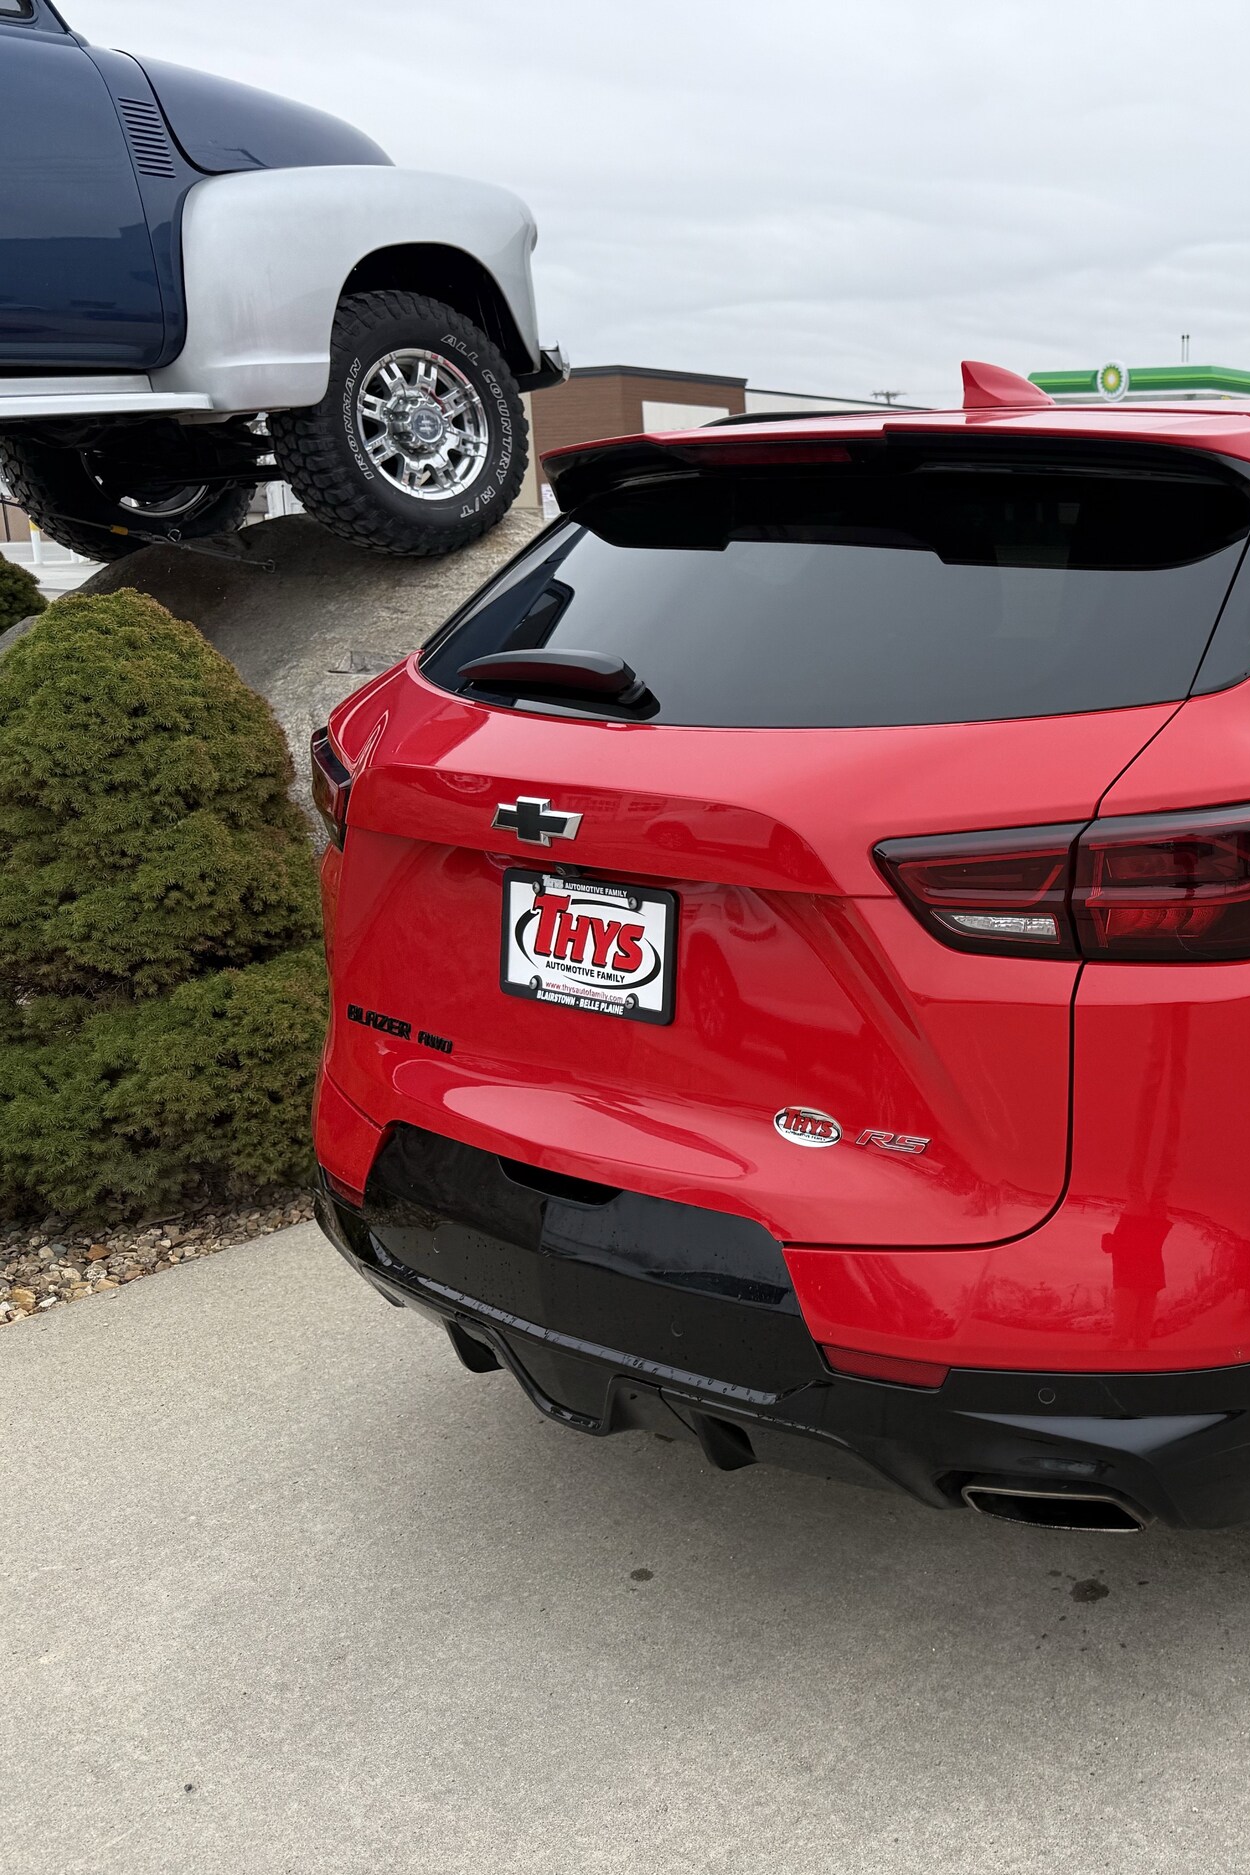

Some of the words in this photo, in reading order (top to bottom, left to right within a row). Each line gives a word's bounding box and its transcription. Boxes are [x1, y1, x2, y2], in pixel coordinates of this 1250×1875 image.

[440, 334, 479, 366] ALL
[342, 357, 374, 480] IRONMAN
[482, 368, 513, 485] COUNTRY
[460, 485, 496, 519] M/T
[565, 882, 604, 894] AUTOMOTIVE
[605, 888, 628, 897] FAMILY
[531, 893, 645, 973] THYS
[545, 960, 595, 978] AUTOMOTIVE
[596, 970, 626, 983] FAMILY
[536, 990, 576, 1006] BLAIRSTOWN
[579, 998, 600, 1011] BELLE
[600, 1003, 624, 1015] PLAINE
[347, 1003, 412, 1040] BLAZER
[783, 1108, 834, 1138] THYS
[856, 1129, 932, 1154] RS
